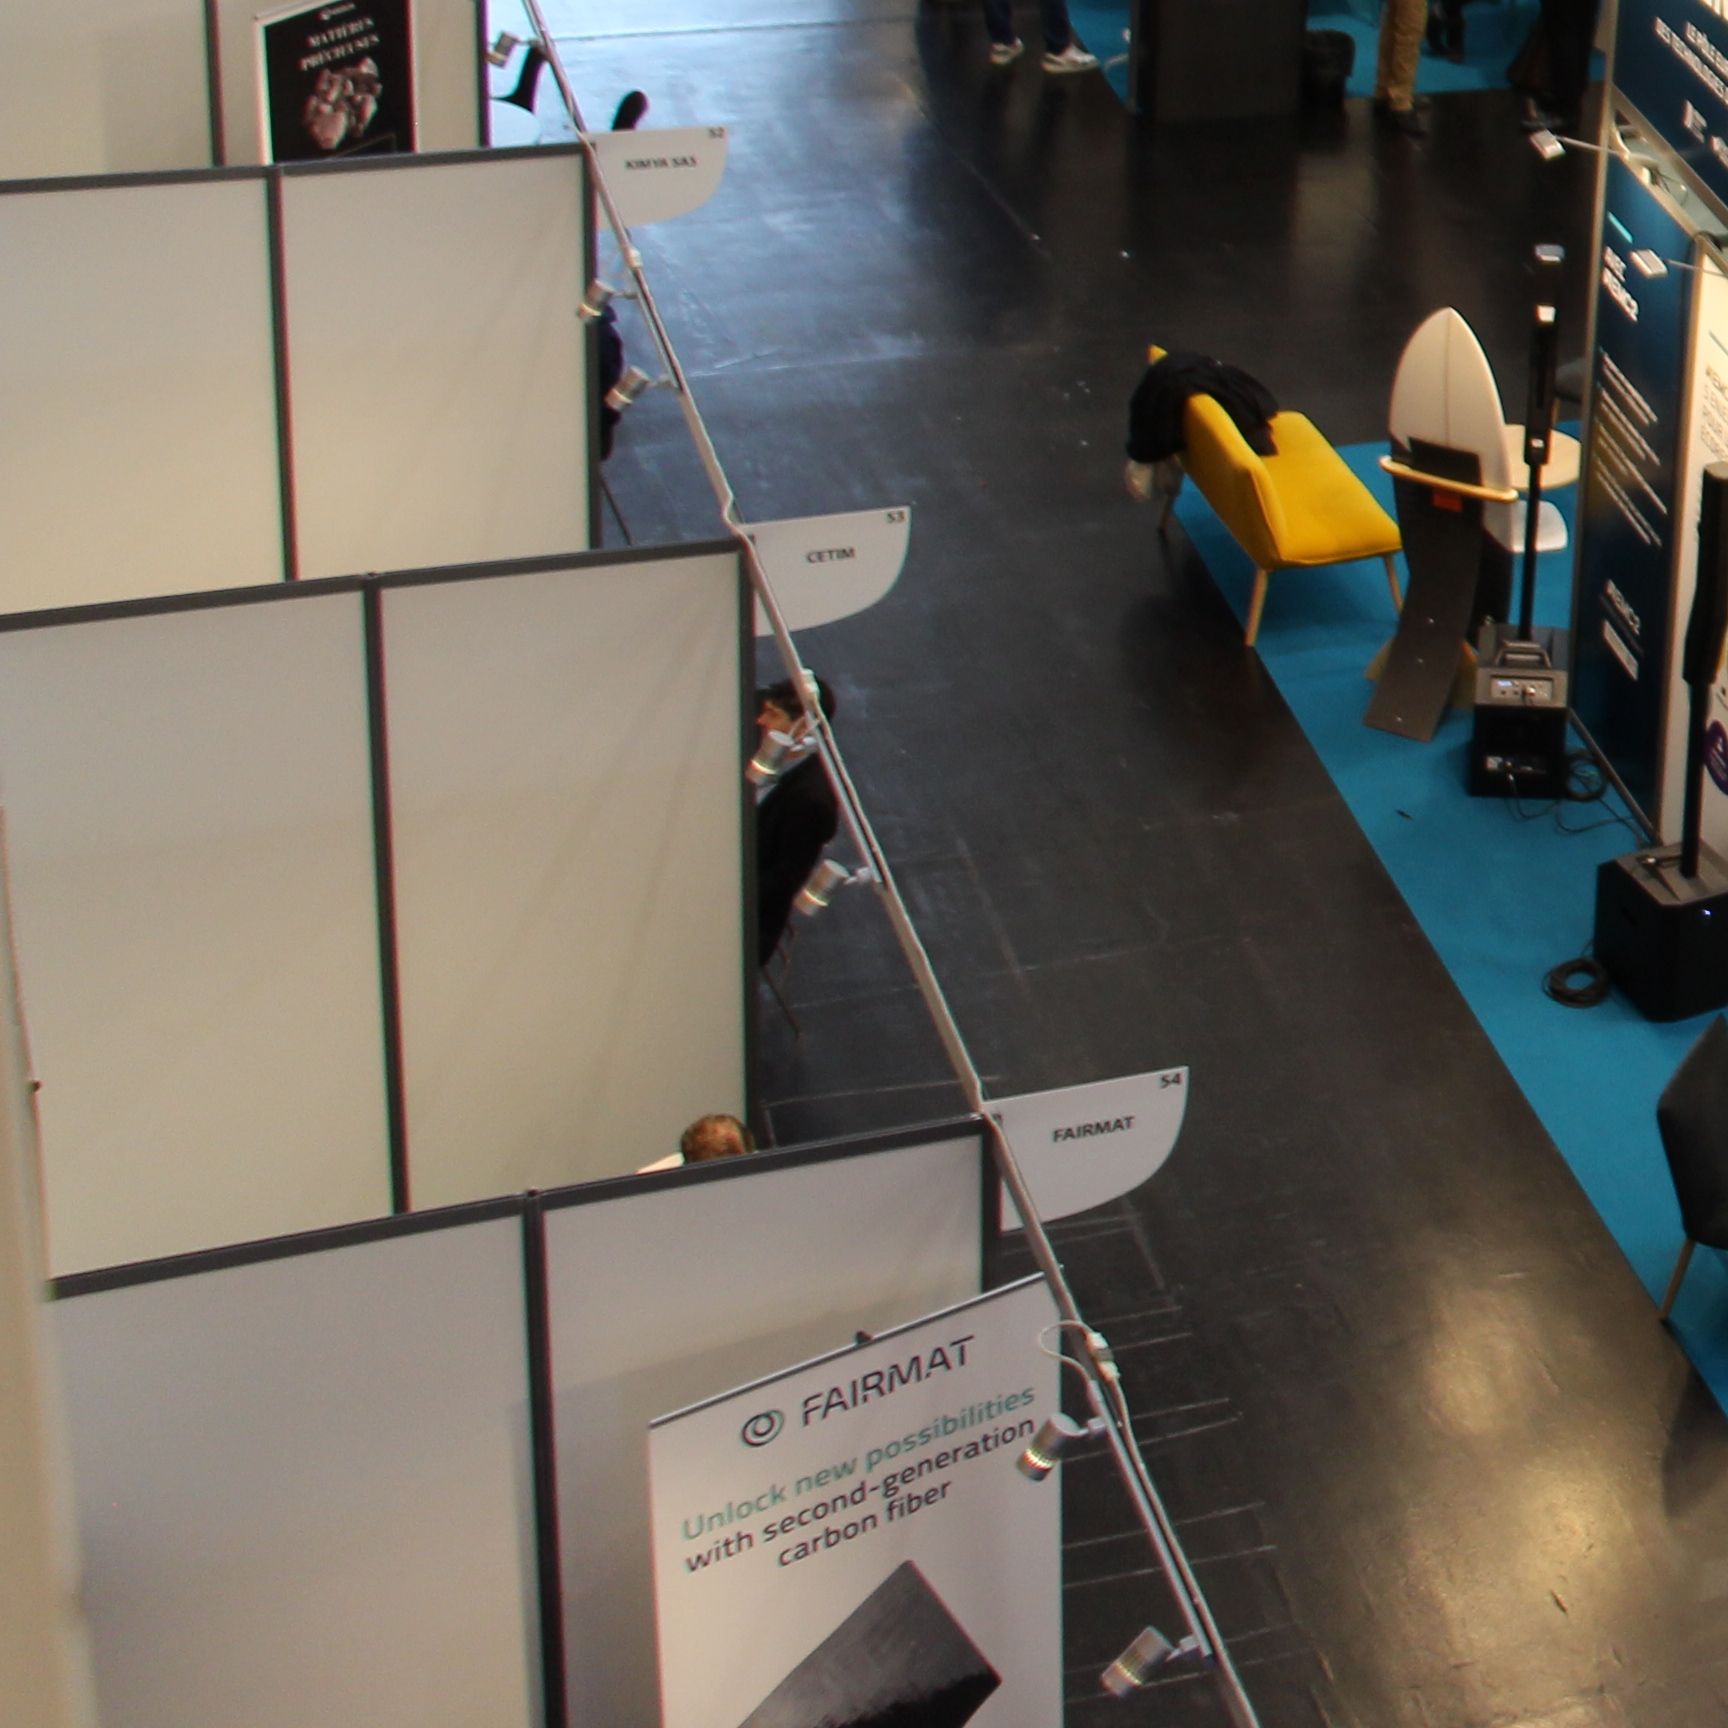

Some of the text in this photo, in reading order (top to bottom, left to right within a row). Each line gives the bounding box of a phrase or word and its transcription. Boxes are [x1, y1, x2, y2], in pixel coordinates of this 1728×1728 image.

[625, 156, 669, 170] KIMYA
[886, 510, 906, 524] S3
[806, 547, 856, 564] CETIM
[1160, 1072, 1182, 1089] S4
[1052, 1115, 1136, 1144] FAIRMAT
[801, 1335, 975, 1427] FAIRMAT
[682, 1385, 1037, 1542] Unlock new possibilities
[685, 1415, 1036, 1572] with second-generation
[778, 1480, 952, 1568] carbon fiber
